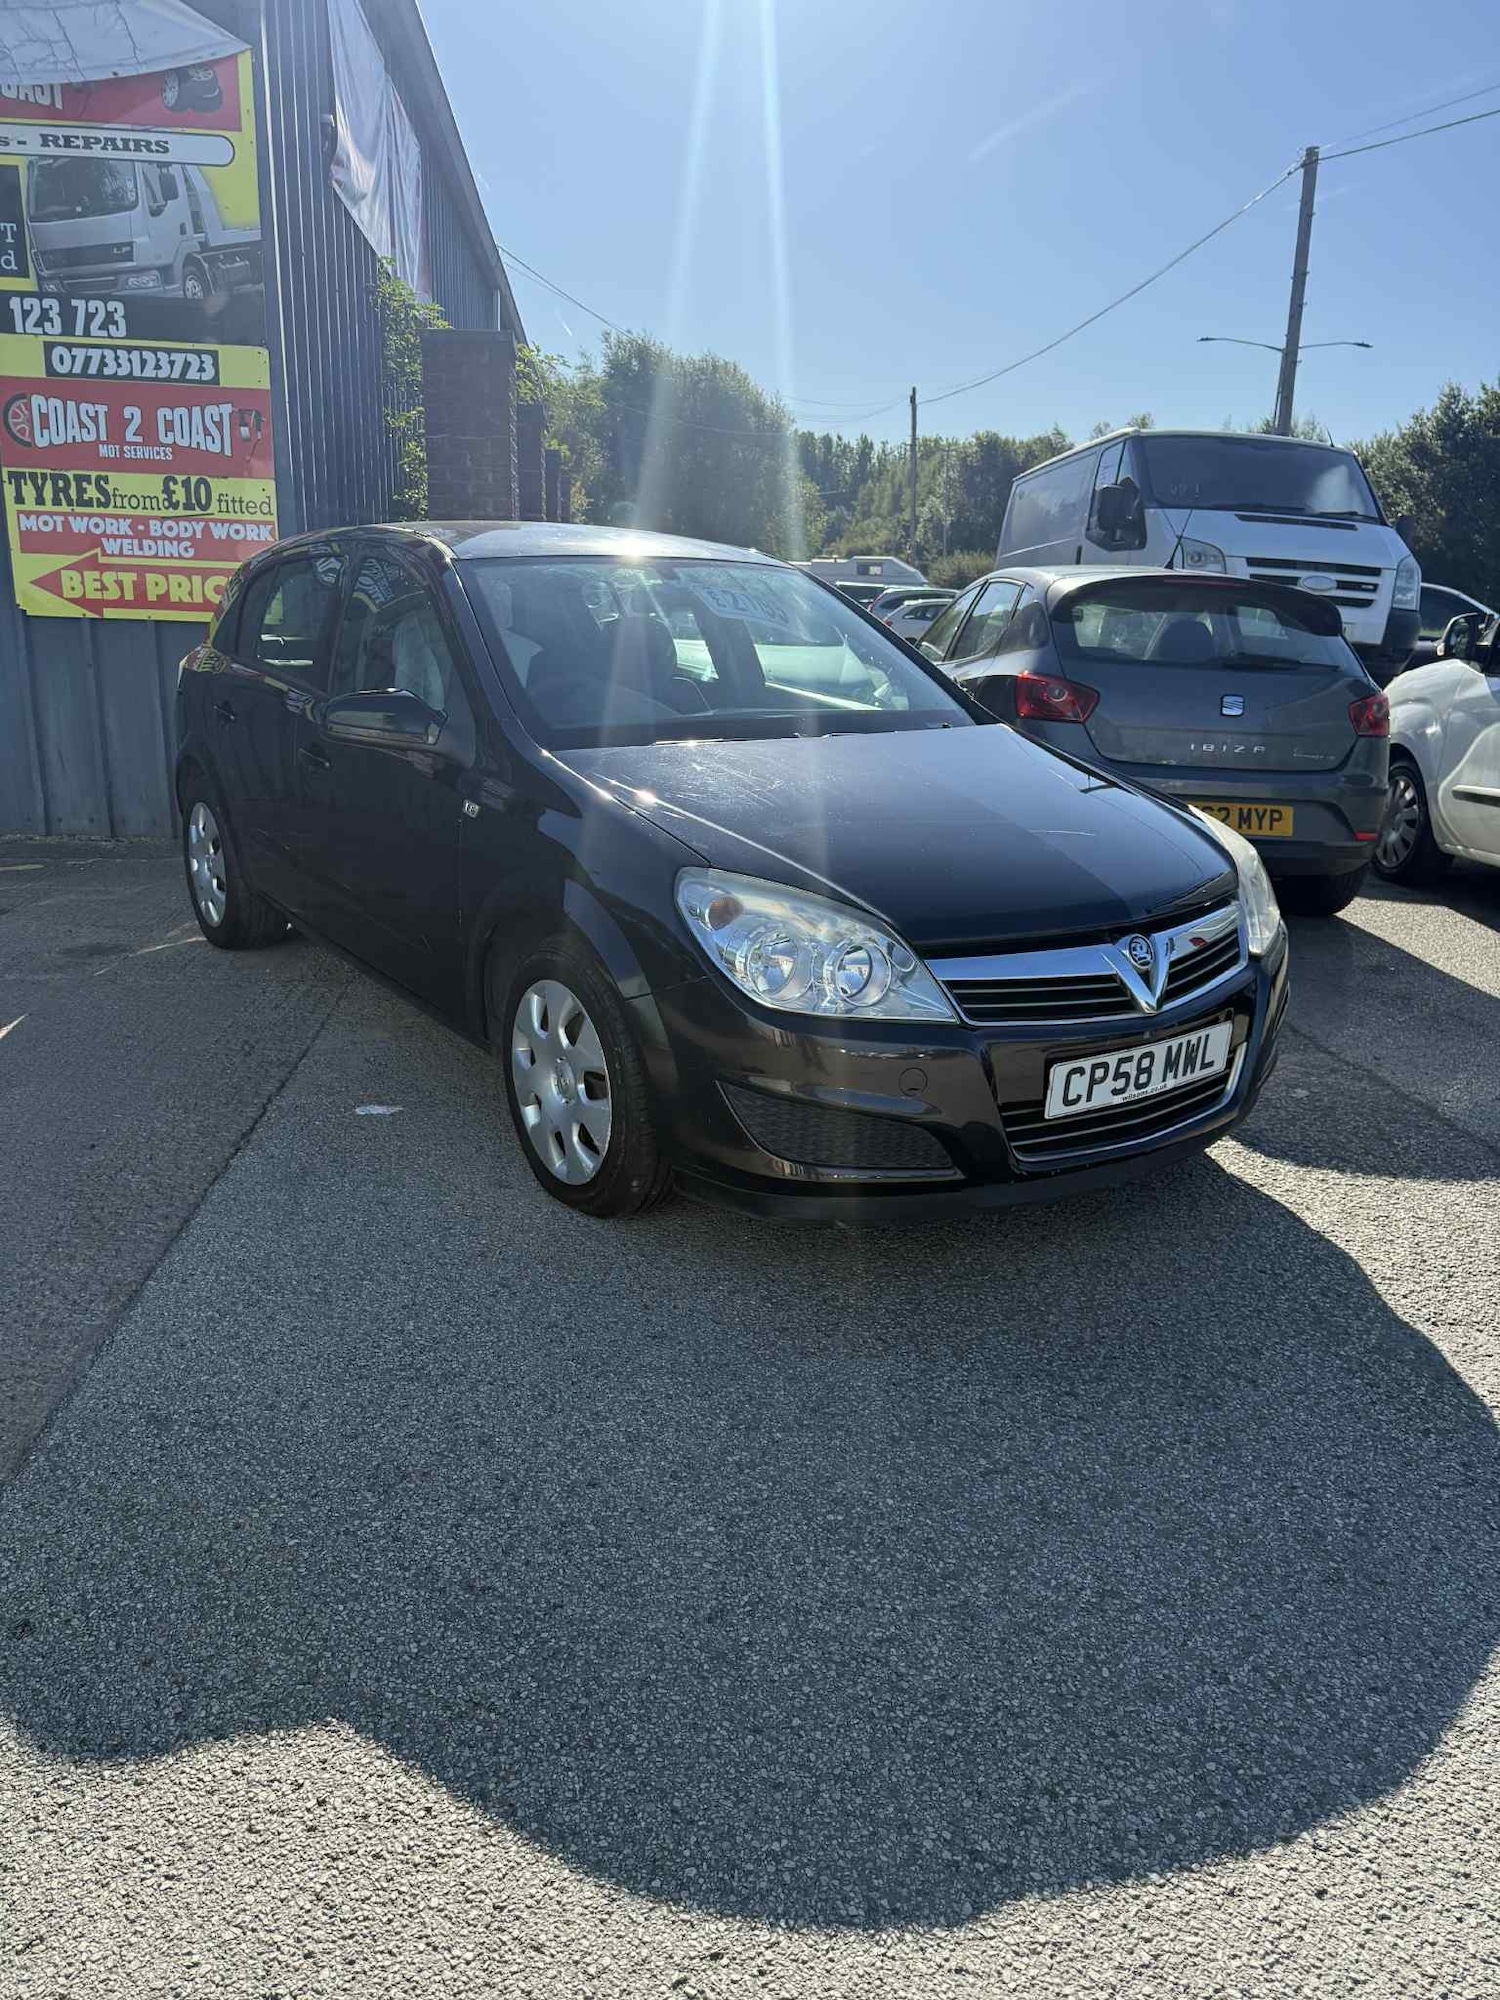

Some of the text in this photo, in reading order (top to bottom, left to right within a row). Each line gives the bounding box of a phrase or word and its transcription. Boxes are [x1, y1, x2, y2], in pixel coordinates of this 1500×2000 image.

[39, 133, 170, 154] REPAIRS
[9, 296, 127, 338] 123 723
[51, 346, 216, 381] 07733123723
[30, 394, 234, 457] COAST 2 COAST
[99, 444, 173, 461] MOT SERVICES
[8, 470, 274, 516] TYRES from £10 fitted
[20, 514, 65, 533] MOT
[70, 517, 134, 537] WORK
[150, 519, 206, 540] BODY
[208, 523, 275, 543] WORK
[100, 536, 195, 559] WELDING
[60, 570, 138, 602] BEST
[145, 572, 232, 605] PRIC
[1237, 806, 1283, 831] MYP
[1062, 1034, 1214, 1107] CP58 MWL
